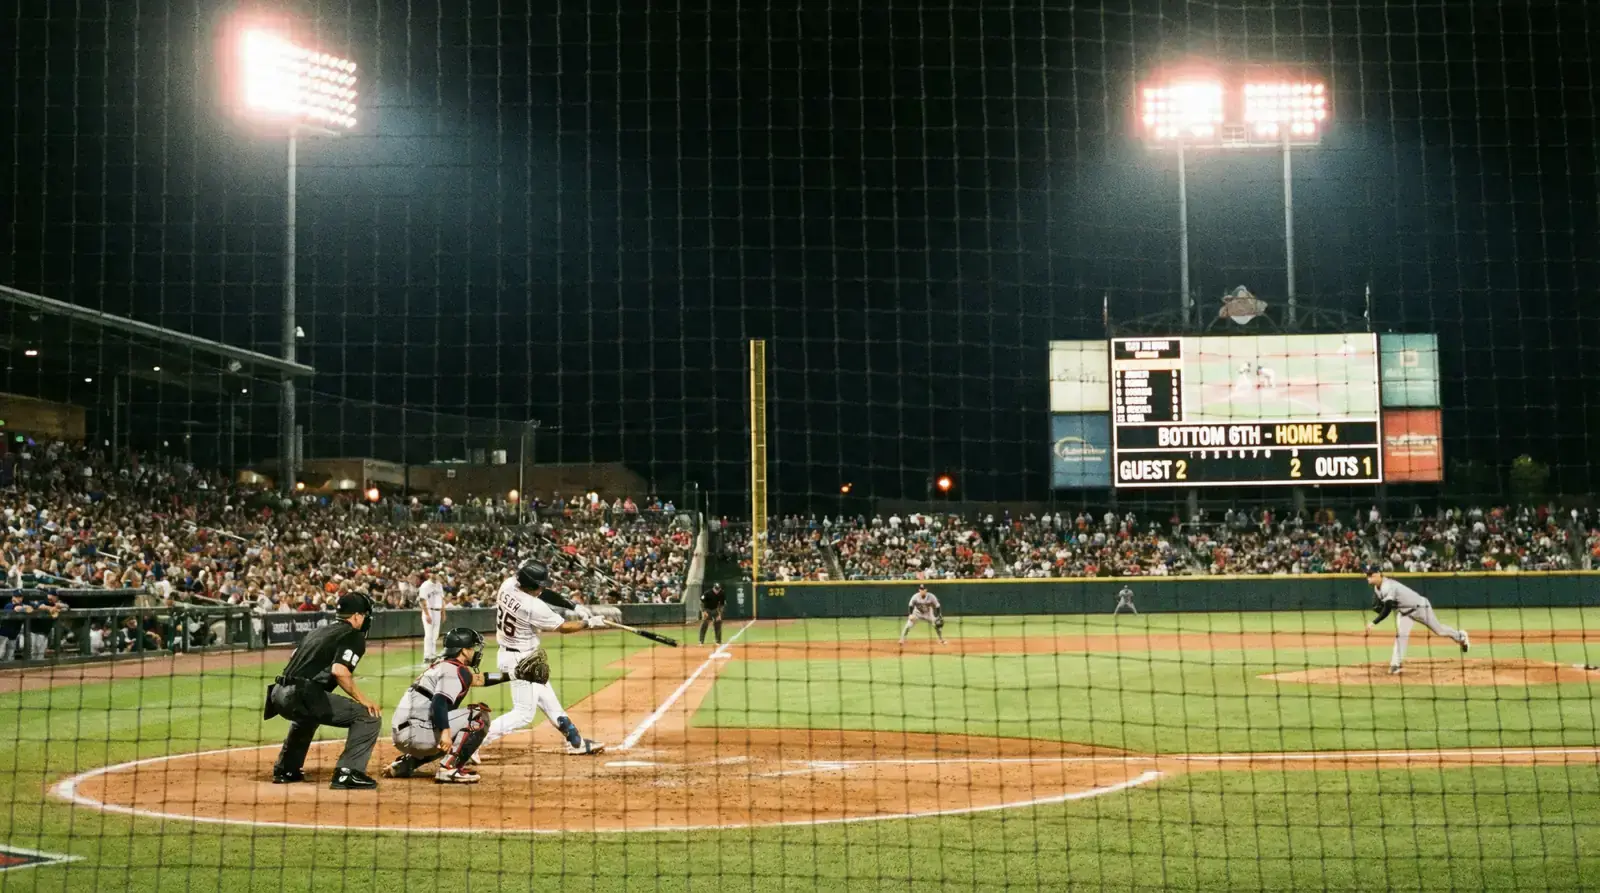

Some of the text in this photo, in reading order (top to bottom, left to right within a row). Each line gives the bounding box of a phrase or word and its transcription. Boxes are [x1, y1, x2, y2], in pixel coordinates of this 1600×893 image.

[1158, 426, 1225, 446] BOTTOM
[1229, 425, 1261, 445] 6TH
[1275, 424, 1323, 444] HOME
[1326, 424, 1338, 443] 4
[1120, 456, 1372, 480] GUEST 2 2 OUTS 1
